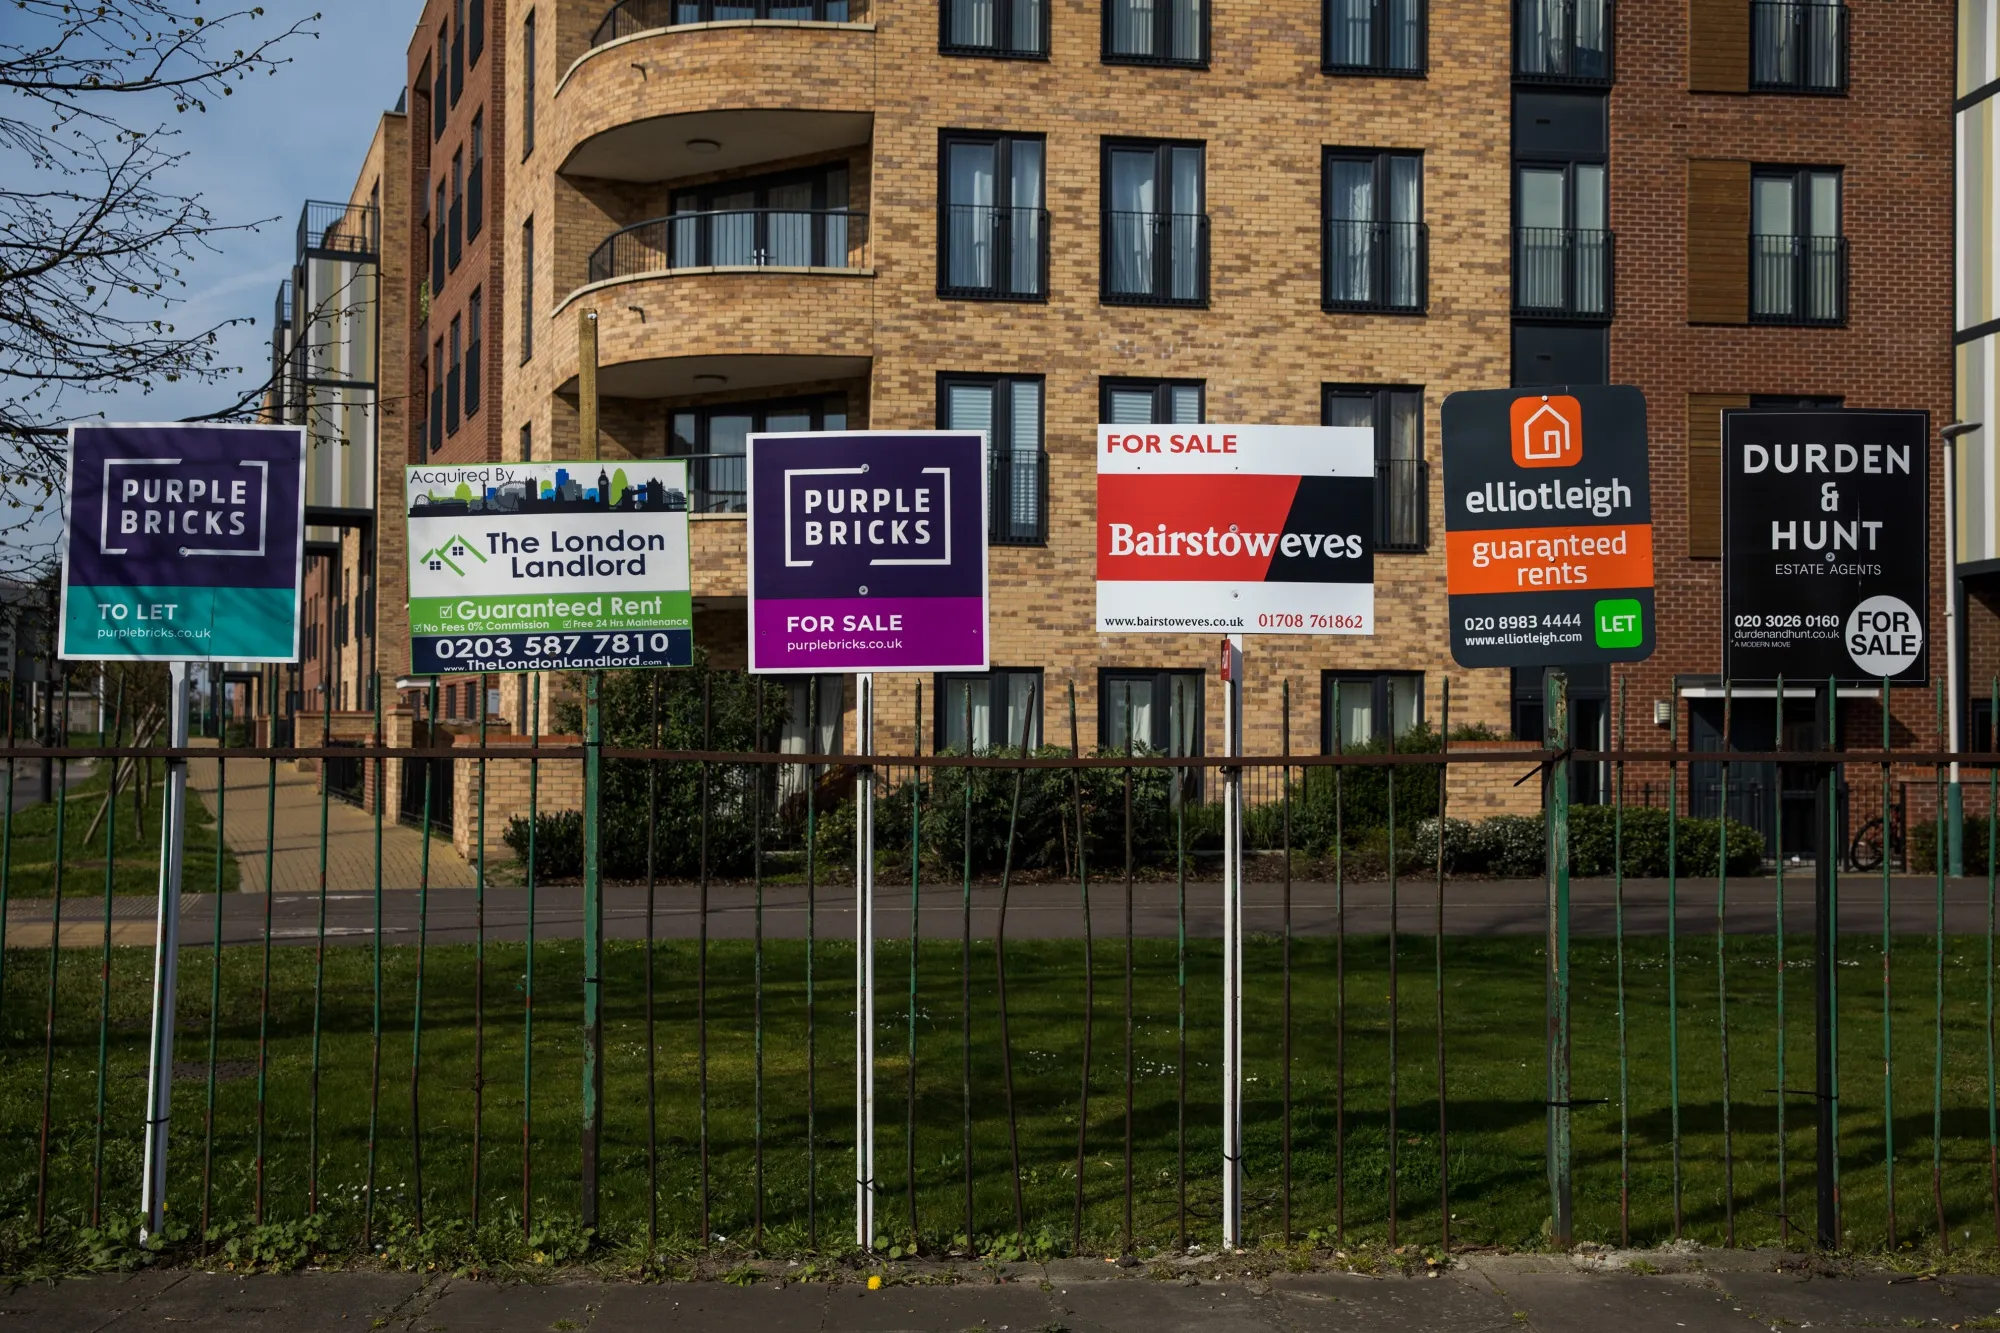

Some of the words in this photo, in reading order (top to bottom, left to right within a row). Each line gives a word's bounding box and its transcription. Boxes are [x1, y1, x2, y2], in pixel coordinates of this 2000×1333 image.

[1107, 434, 1162, 453] FOR
[1169, 434, 1237, 453] SALE
[1743, 444, 1910, 475] DURDEN
[409, 467, 490, 486] Acquired
[495, 468, 515, 484] By
[122, 479, 247, 504] PURPLE
[805, 488, 931, 514] PURPLE
[1465, 478, 1632, 517] elliotleigh
[1821, 482, 1839, 511] &
[121, 510, 245, 536] BRICKS
[486, 532, 540, 554] The
[552, 530, 665, 552] London
[805, 520, 931, 546] BRICKS
[1772, 520, 1883, 550] HUNT
[1472, 530, 1627, 568] guaranteed
[512, 554, 646, 578] Landlord
[1517, 562, 1588, 586] rents
[1775, 564, 1824, 575] ESTATE
[1829, 564, 1882, 575] AGENTS
[98, 604, 128, 620] TO
[137, 603, 178, 620] LET
[457, 597, 602, 621] Guaranteed
[611, 596, 662, 616] Rent
[423, 623, 438, 632] No
[441, 622, 465, 632] Fees
[468, 622, 484, 631] 0%
[486, 620, 550, 630] Commission
[573, 620, 593, 628] Free
[596, 619, 607, 628] 24
[610, 619, 624, 627] Hrs
[626, 618, 689, 627] Maintenance
[787, 615, 835, 633] FOR
[842, 614, 903, 632] SALE
[1104, 616, 1244, 627] www.bairstoweves.co.uk
[1258, 614, 1304, 628] 01708
[1310, 614, 1363, 629] 761862
[1464, 617, 1495, 631] 020
[1499, 615, 1538, 629] 8983
[1542, 614, 1582, 628] 4444
[1601, 615, 1636, 633] LET
[1734, 615, 1762, 627] 020
[1765, 615, 1801, 627] 3026
[1805, 615, 1840, 627] 0160
[1857, 611, 1910, 633] FOR
[97, 627, 211, 640] purplebricks.co.uk
[1465, 632, 1583, 646] www.elliotleigh.com
[1734, 629, 1840, 639] durdenandhunt.co.uk
[435, 637, 513, 659] 0203
[523, 635, 581, 656] 587
[592, 633, 669, 654] 7810
[787, 638, 903, 652] purplebricks.co.uk
[1850, 634, 1917, 656] SALE
[443, 655, 662, 672] www.TheLondonLandlord.com
